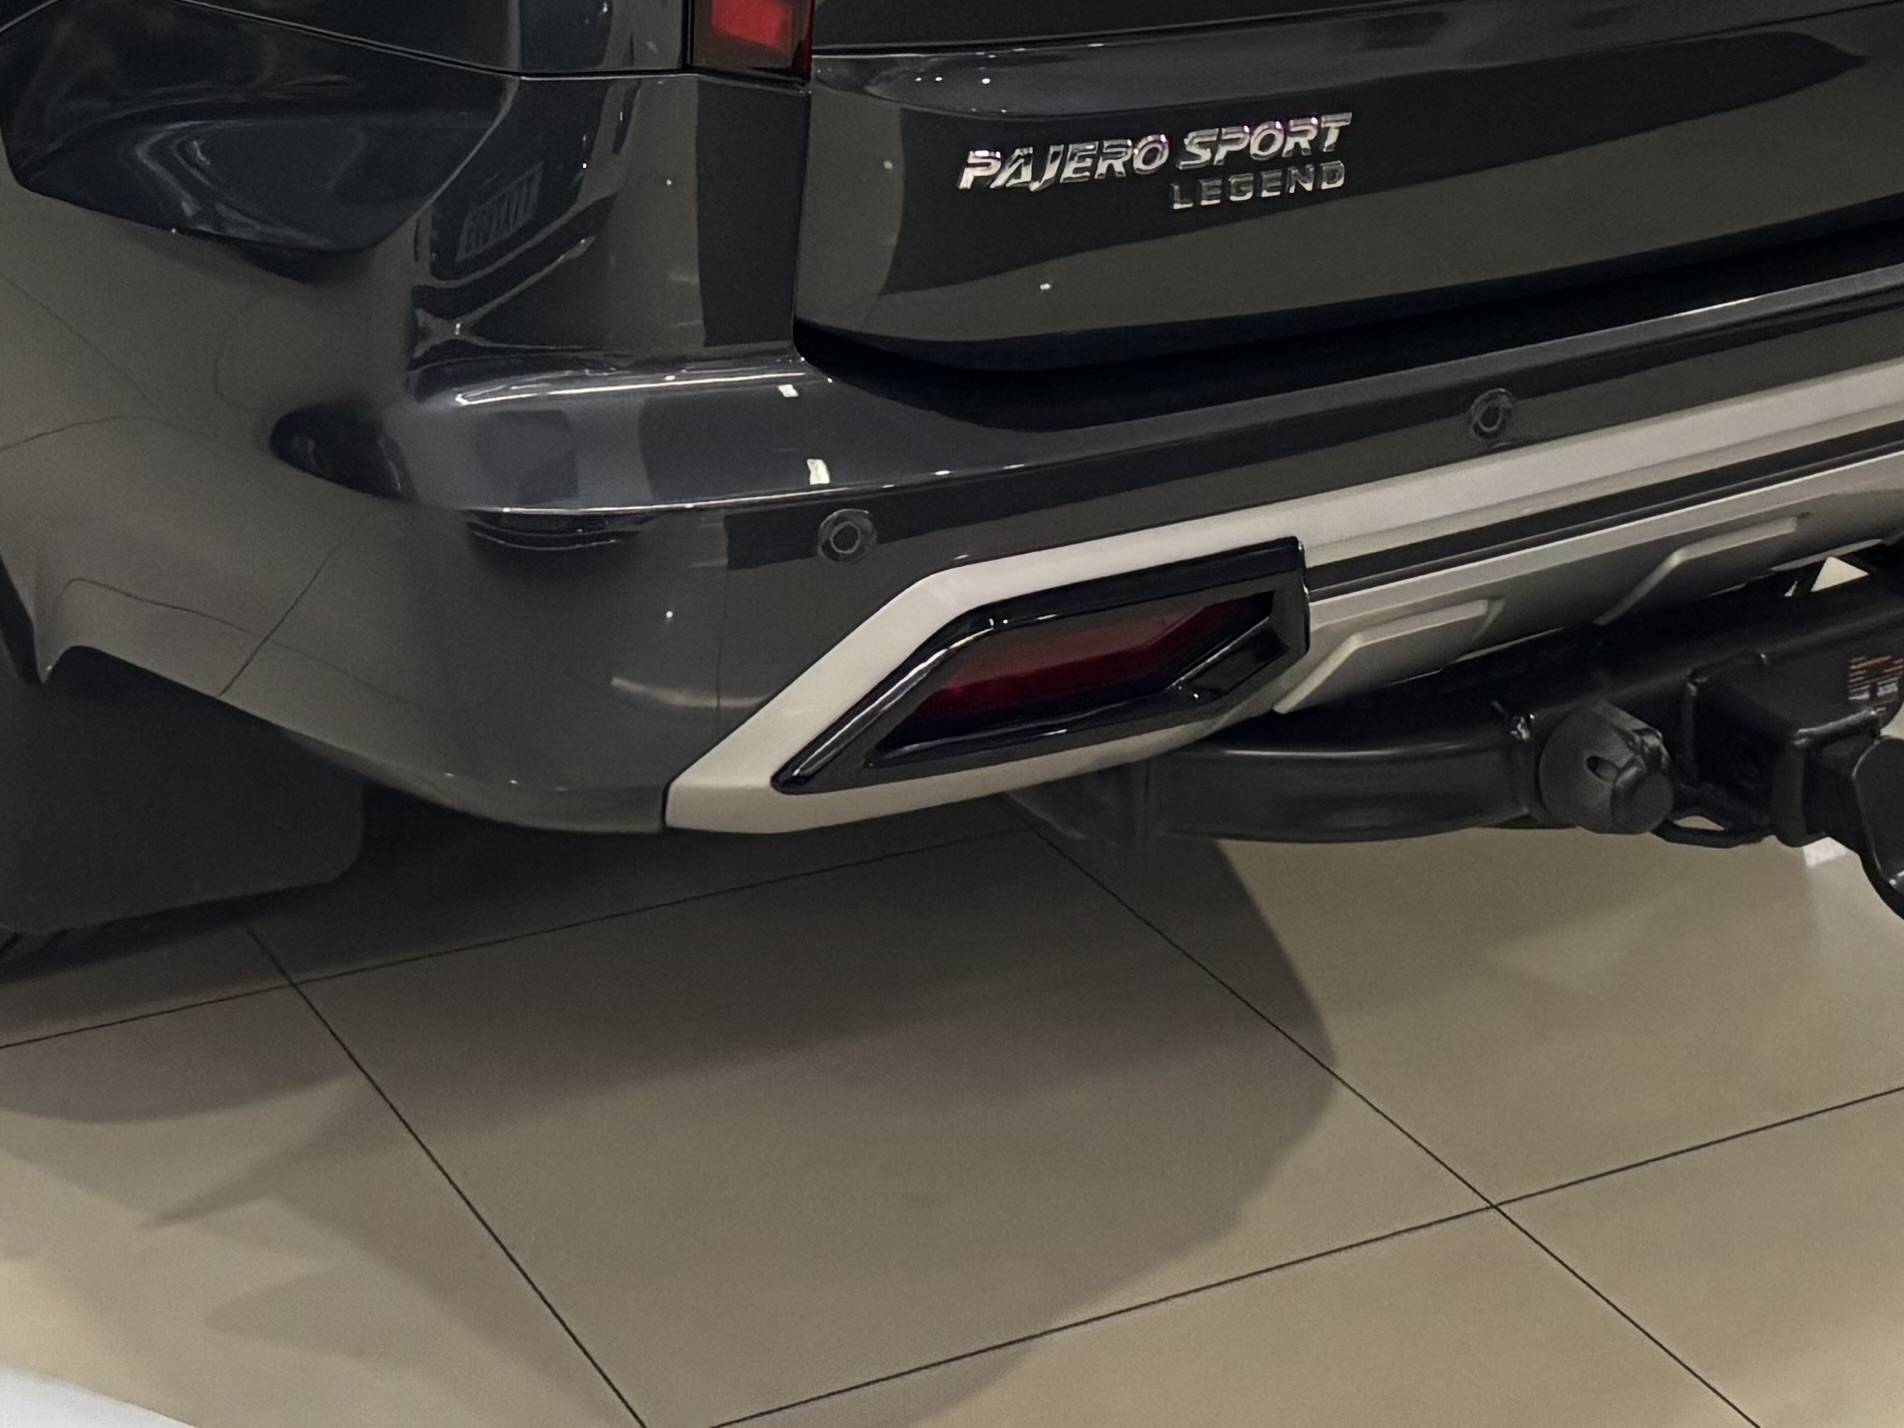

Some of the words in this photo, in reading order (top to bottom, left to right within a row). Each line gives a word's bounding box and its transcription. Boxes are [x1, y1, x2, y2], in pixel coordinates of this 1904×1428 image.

[957, 133, 1171, 192] PAJERO
[1175, 111, 1353, 172] SPORT
[1170, 160, 1345, 210] LEGEND
